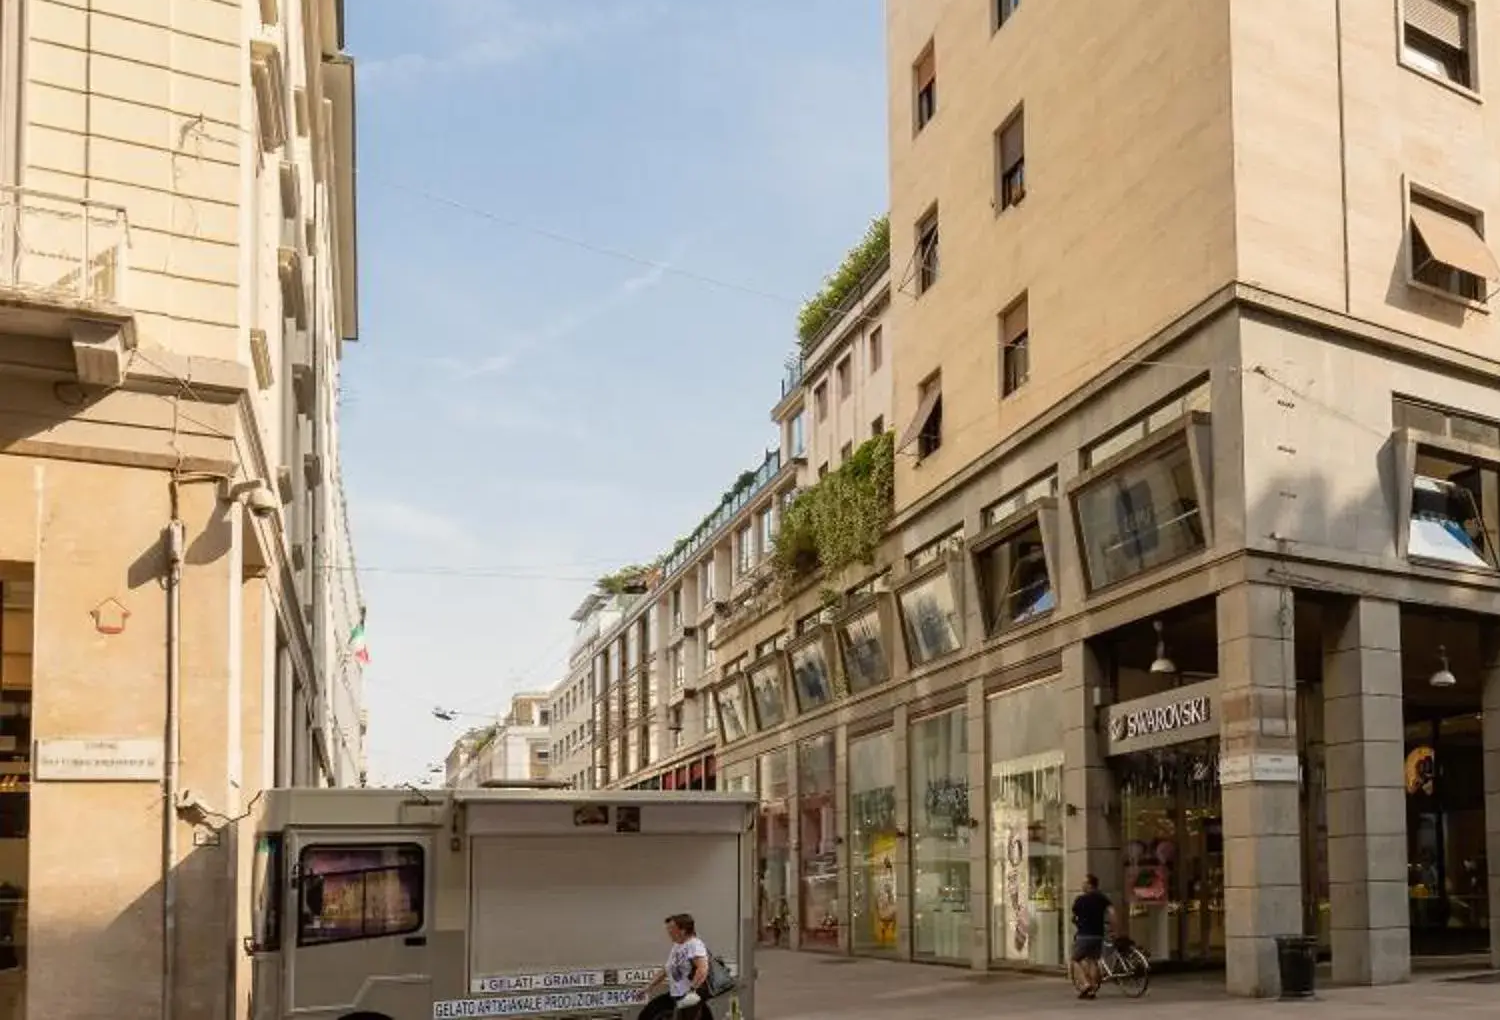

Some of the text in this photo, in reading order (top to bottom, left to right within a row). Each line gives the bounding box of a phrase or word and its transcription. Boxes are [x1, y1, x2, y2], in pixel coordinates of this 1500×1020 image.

[1127, 696, 1209, 737] SWAROVSKI
[489, 977, 533, 991] GELATI
[544, 973, 595, 987] GRANITE
[435, 1001, 475, 1017] GELATO
[478, 995, 541, 1013] ARTIGIANALE
